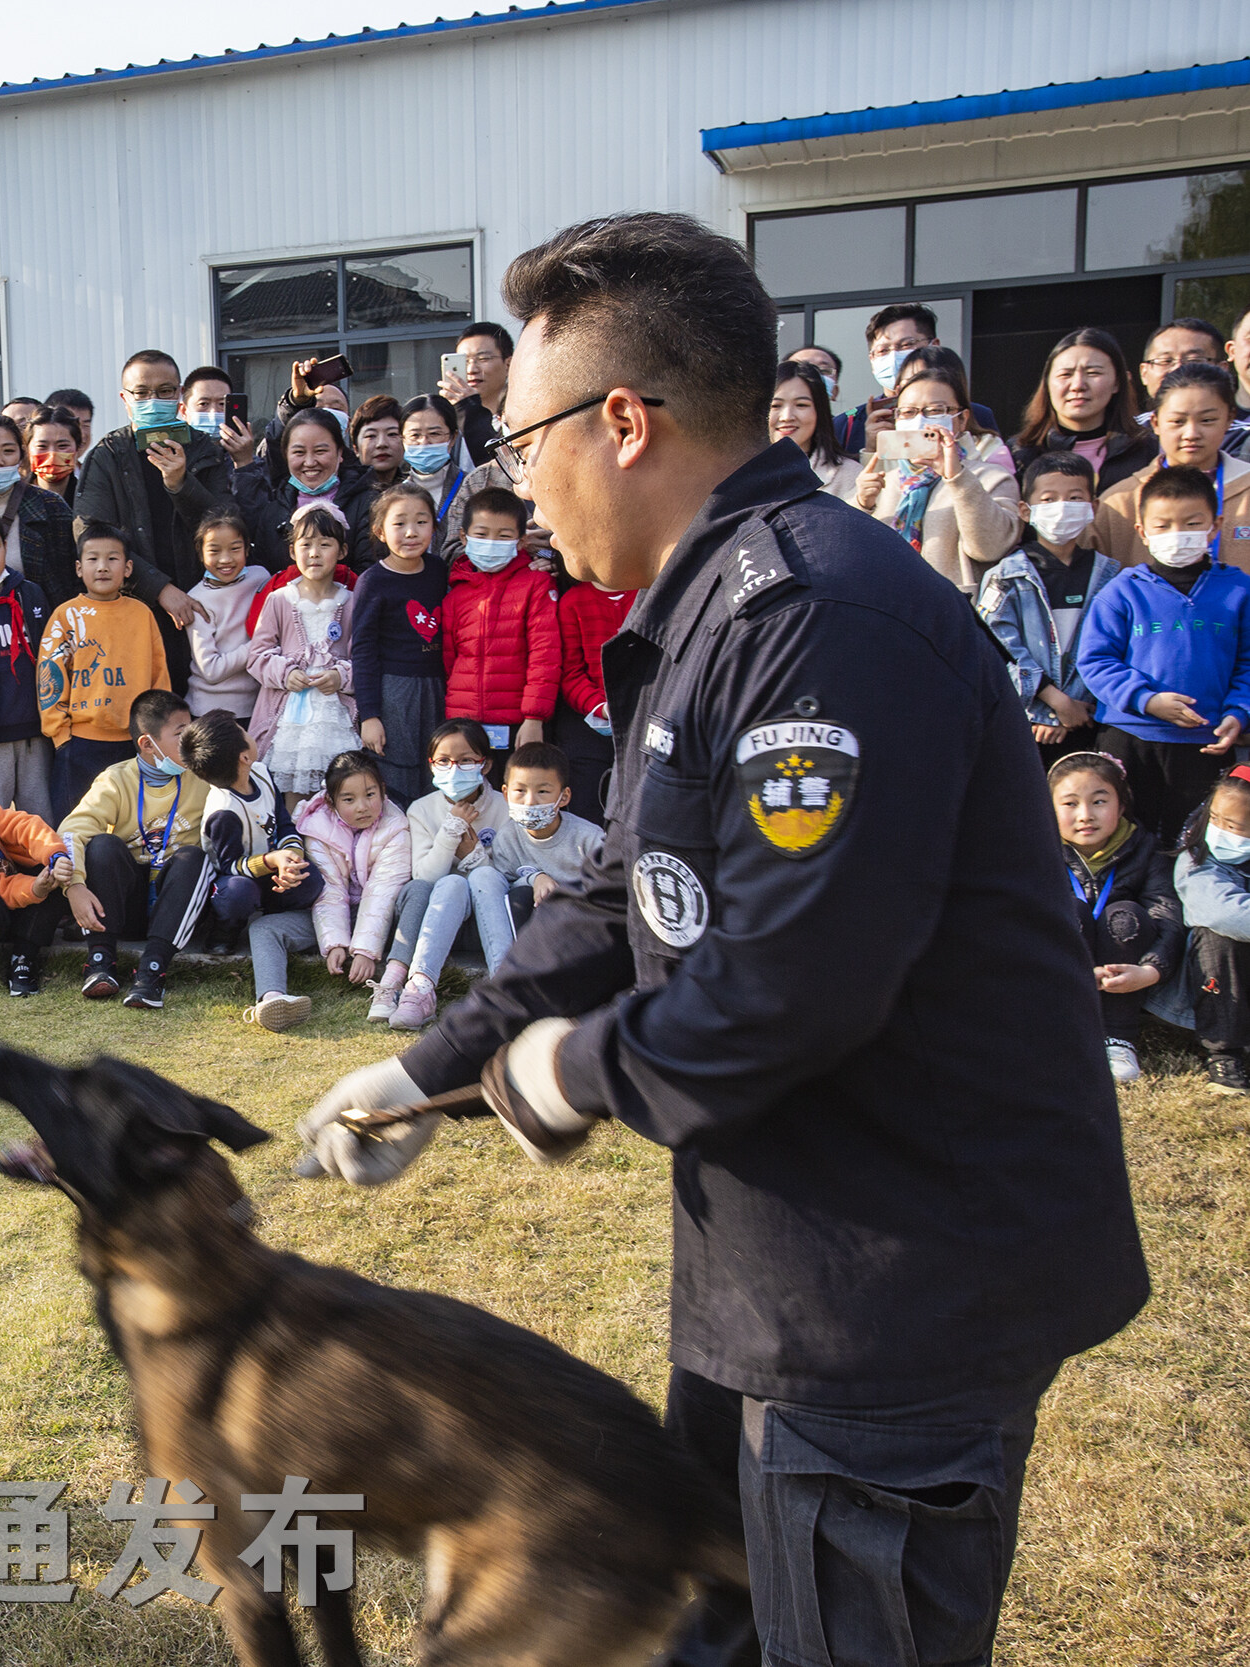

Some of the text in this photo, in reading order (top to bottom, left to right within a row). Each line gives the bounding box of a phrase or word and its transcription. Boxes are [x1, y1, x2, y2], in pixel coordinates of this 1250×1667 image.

[733, 568, 777, 604] NTFJ
[750, 726, 844, 750] FU JING
[762, 776, 831, 807] 辅警
